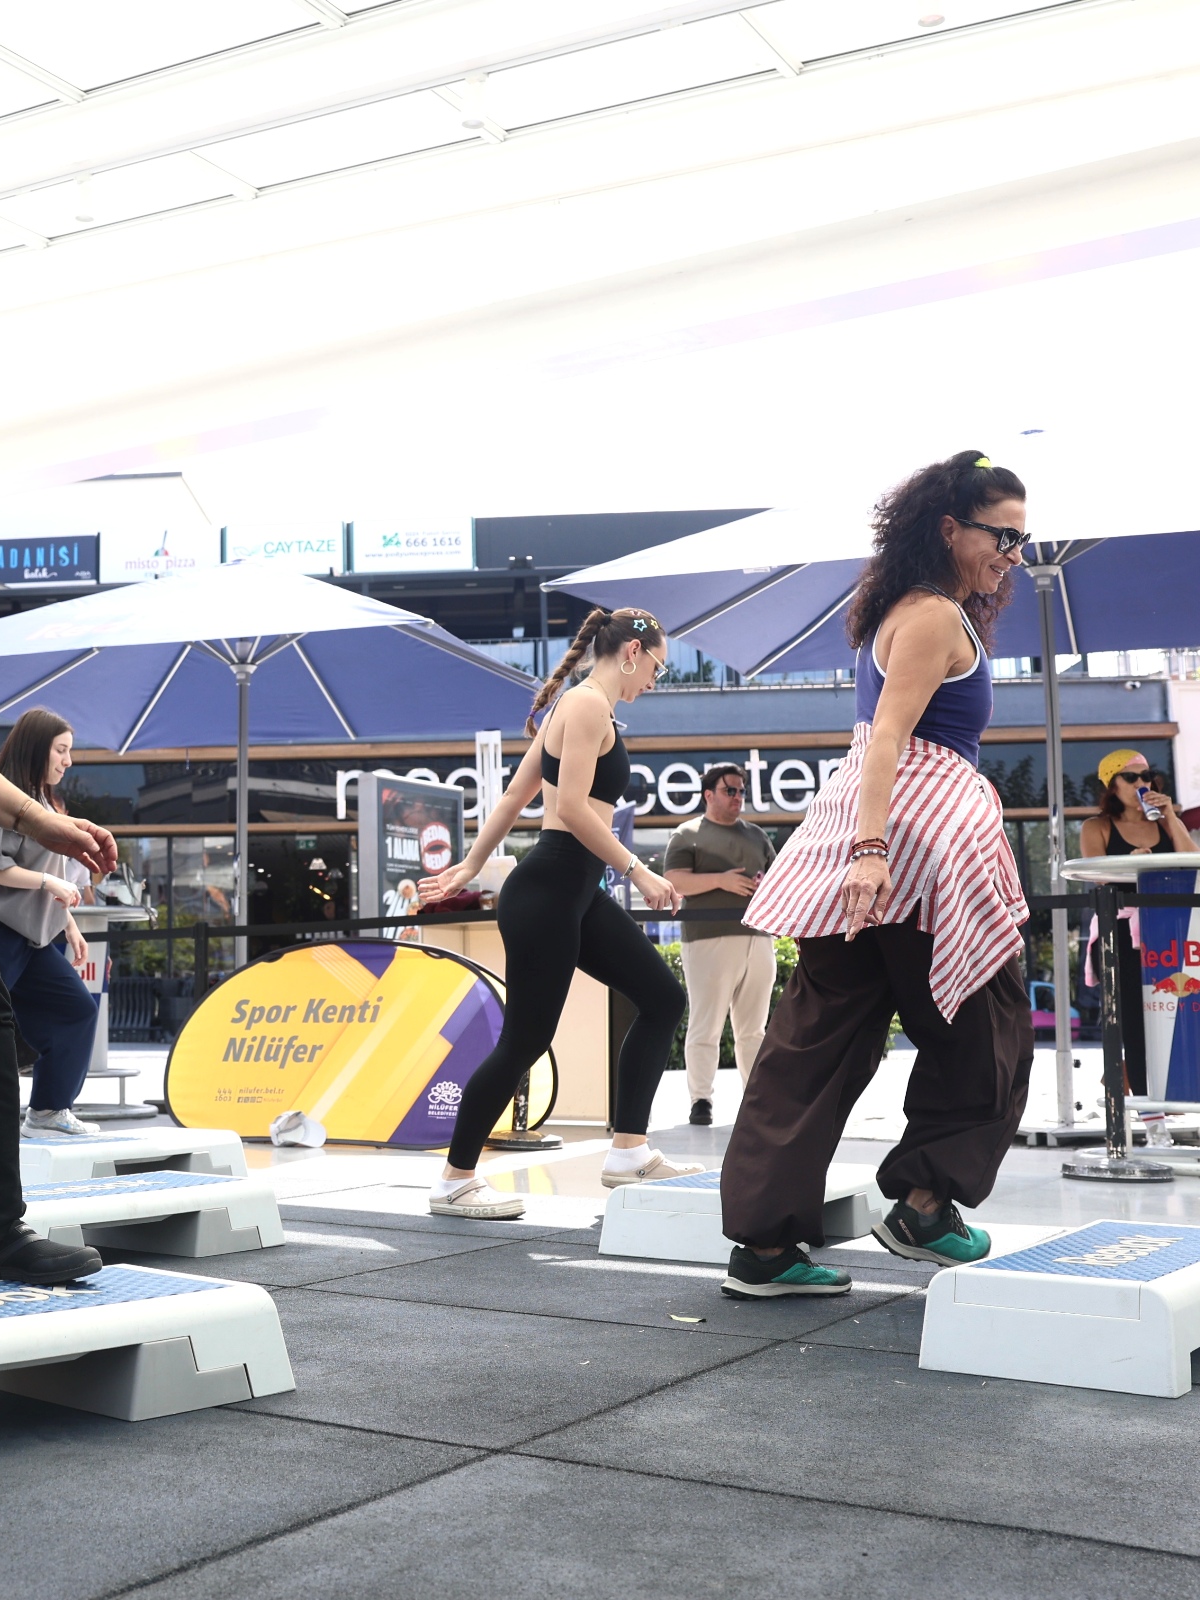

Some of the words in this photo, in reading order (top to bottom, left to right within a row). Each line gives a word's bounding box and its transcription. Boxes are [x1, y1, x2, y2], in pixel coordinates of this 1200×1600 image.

[405, 537, 428, 548] 666
[432, 535, 462, 547] 1616
[125, 557, 159, 570] misto
[165, 556, 196, 570] pizza
[629, 749, 841, 817] ceter
[231, 999, 297, 1030] Spor
[302, 996, 384, 1024] Kenti
[222, 1035, 324, 1069] Nilüfer
[239, 1086, 285, 1095] nilufer.bel.tr
[428, 1103, 459, 1111] NİLÜFER
[462, 1207, 497, 1217] crocs
